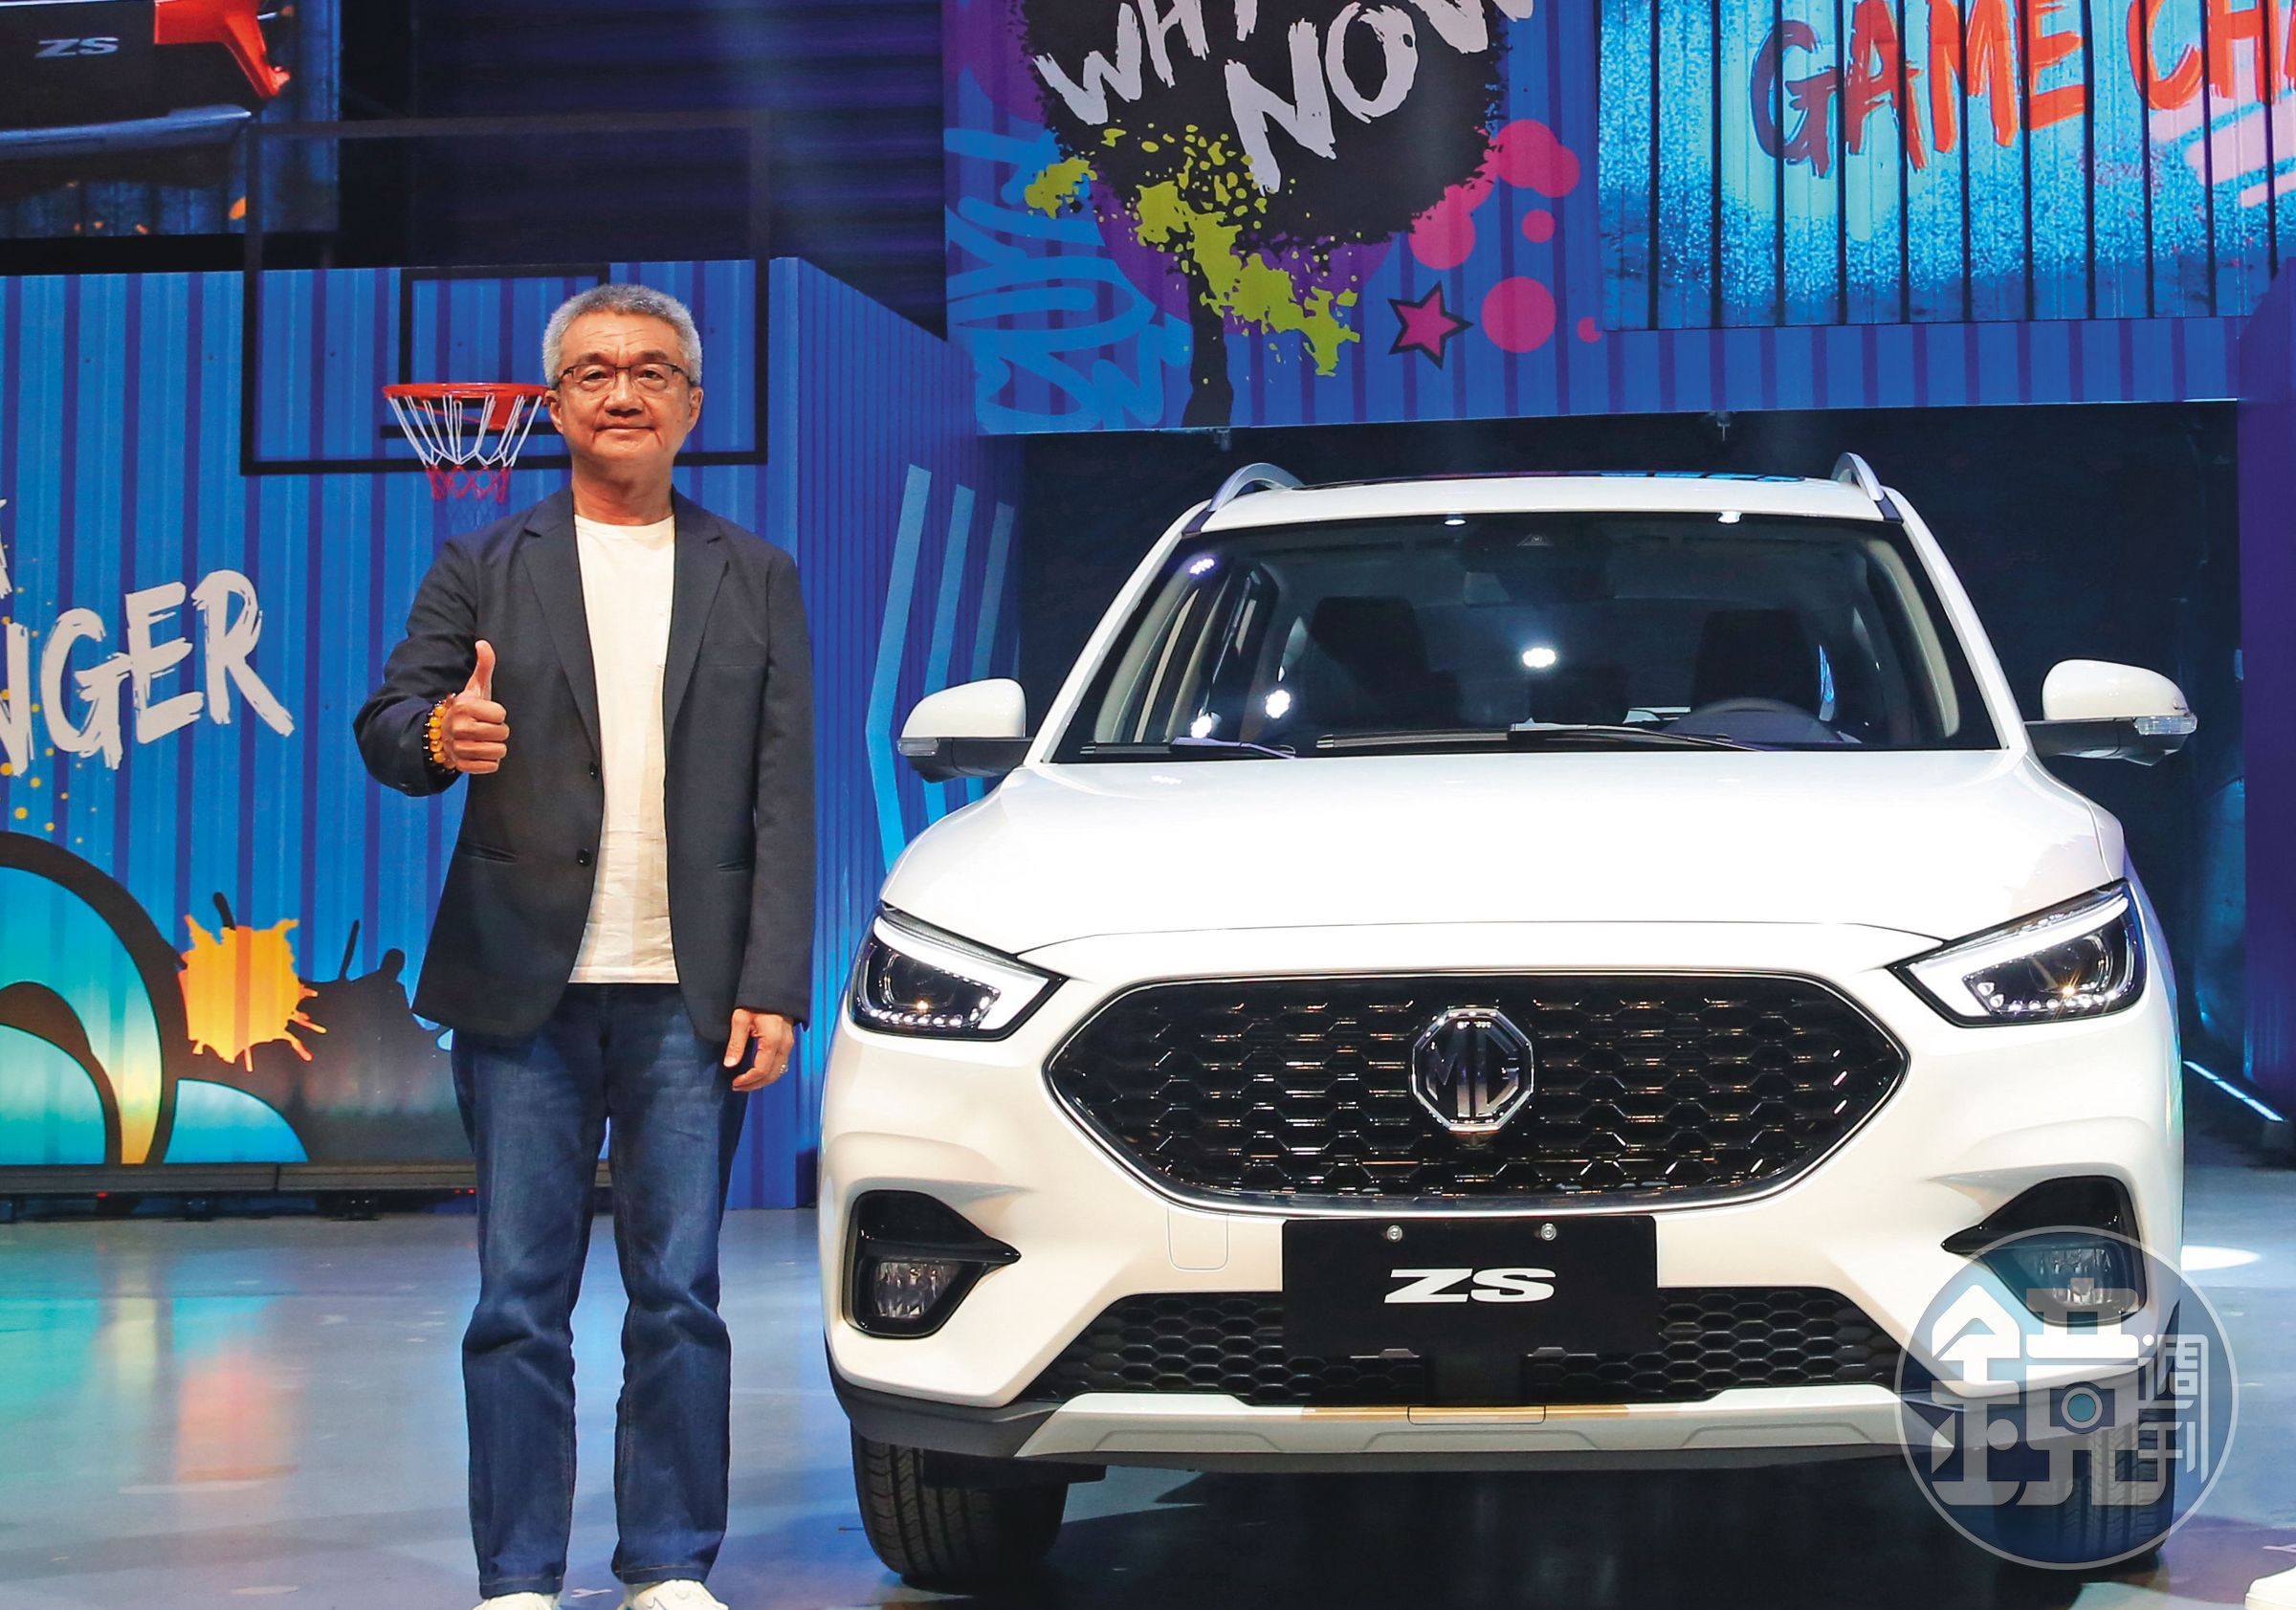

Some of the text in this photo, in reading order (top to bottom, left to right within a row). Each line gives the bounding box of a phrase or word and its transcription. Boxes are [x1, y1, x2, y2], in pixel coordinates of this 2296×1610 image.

[34, 36, 120, 58] ZS
[1750, 0, 2296, 179] GAME CH
[1424, 1014, 1525, 1121] MG
[1384, 1268, 1556, 1304] ZS
